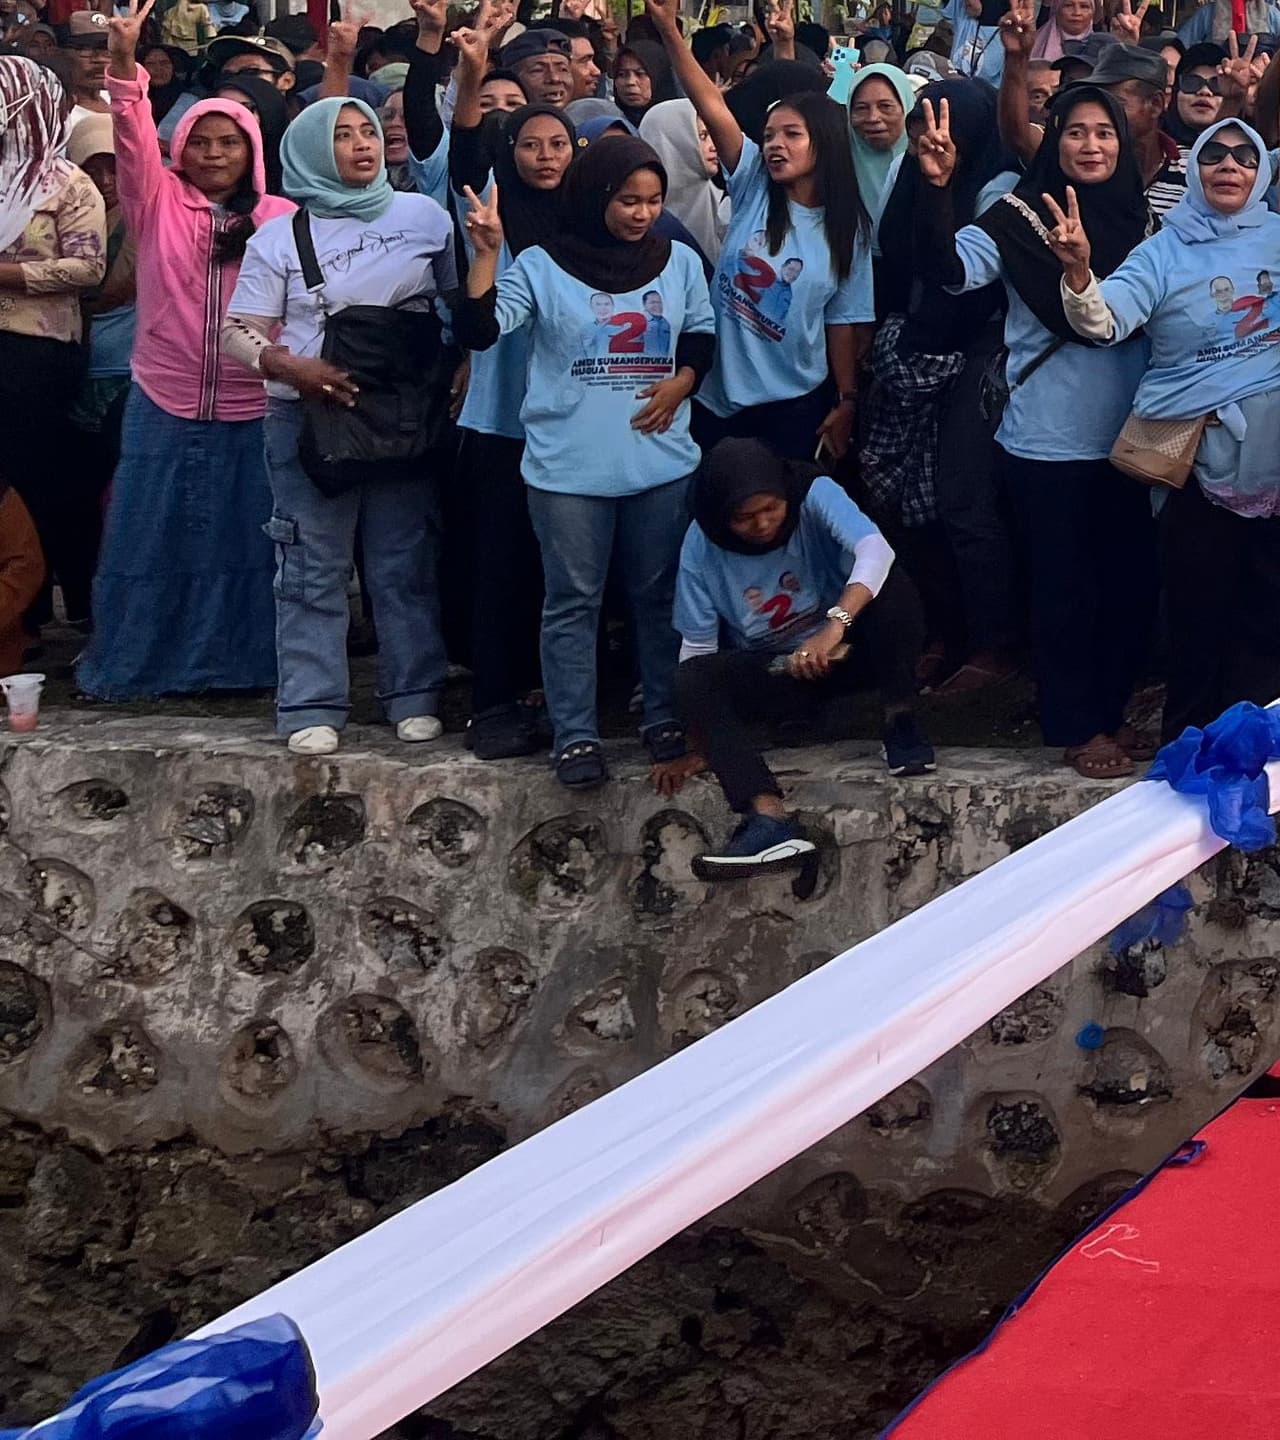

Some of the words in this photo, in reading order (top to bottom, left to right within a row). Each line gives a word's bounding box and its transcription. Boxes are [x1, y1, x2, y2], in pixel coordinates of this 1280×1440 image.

[734, 256, 777, 304] 2
[608, 312, 648, 353] 2
[1231, 294, 1270, 340] 2
[761, 593, 800, 630] 2
